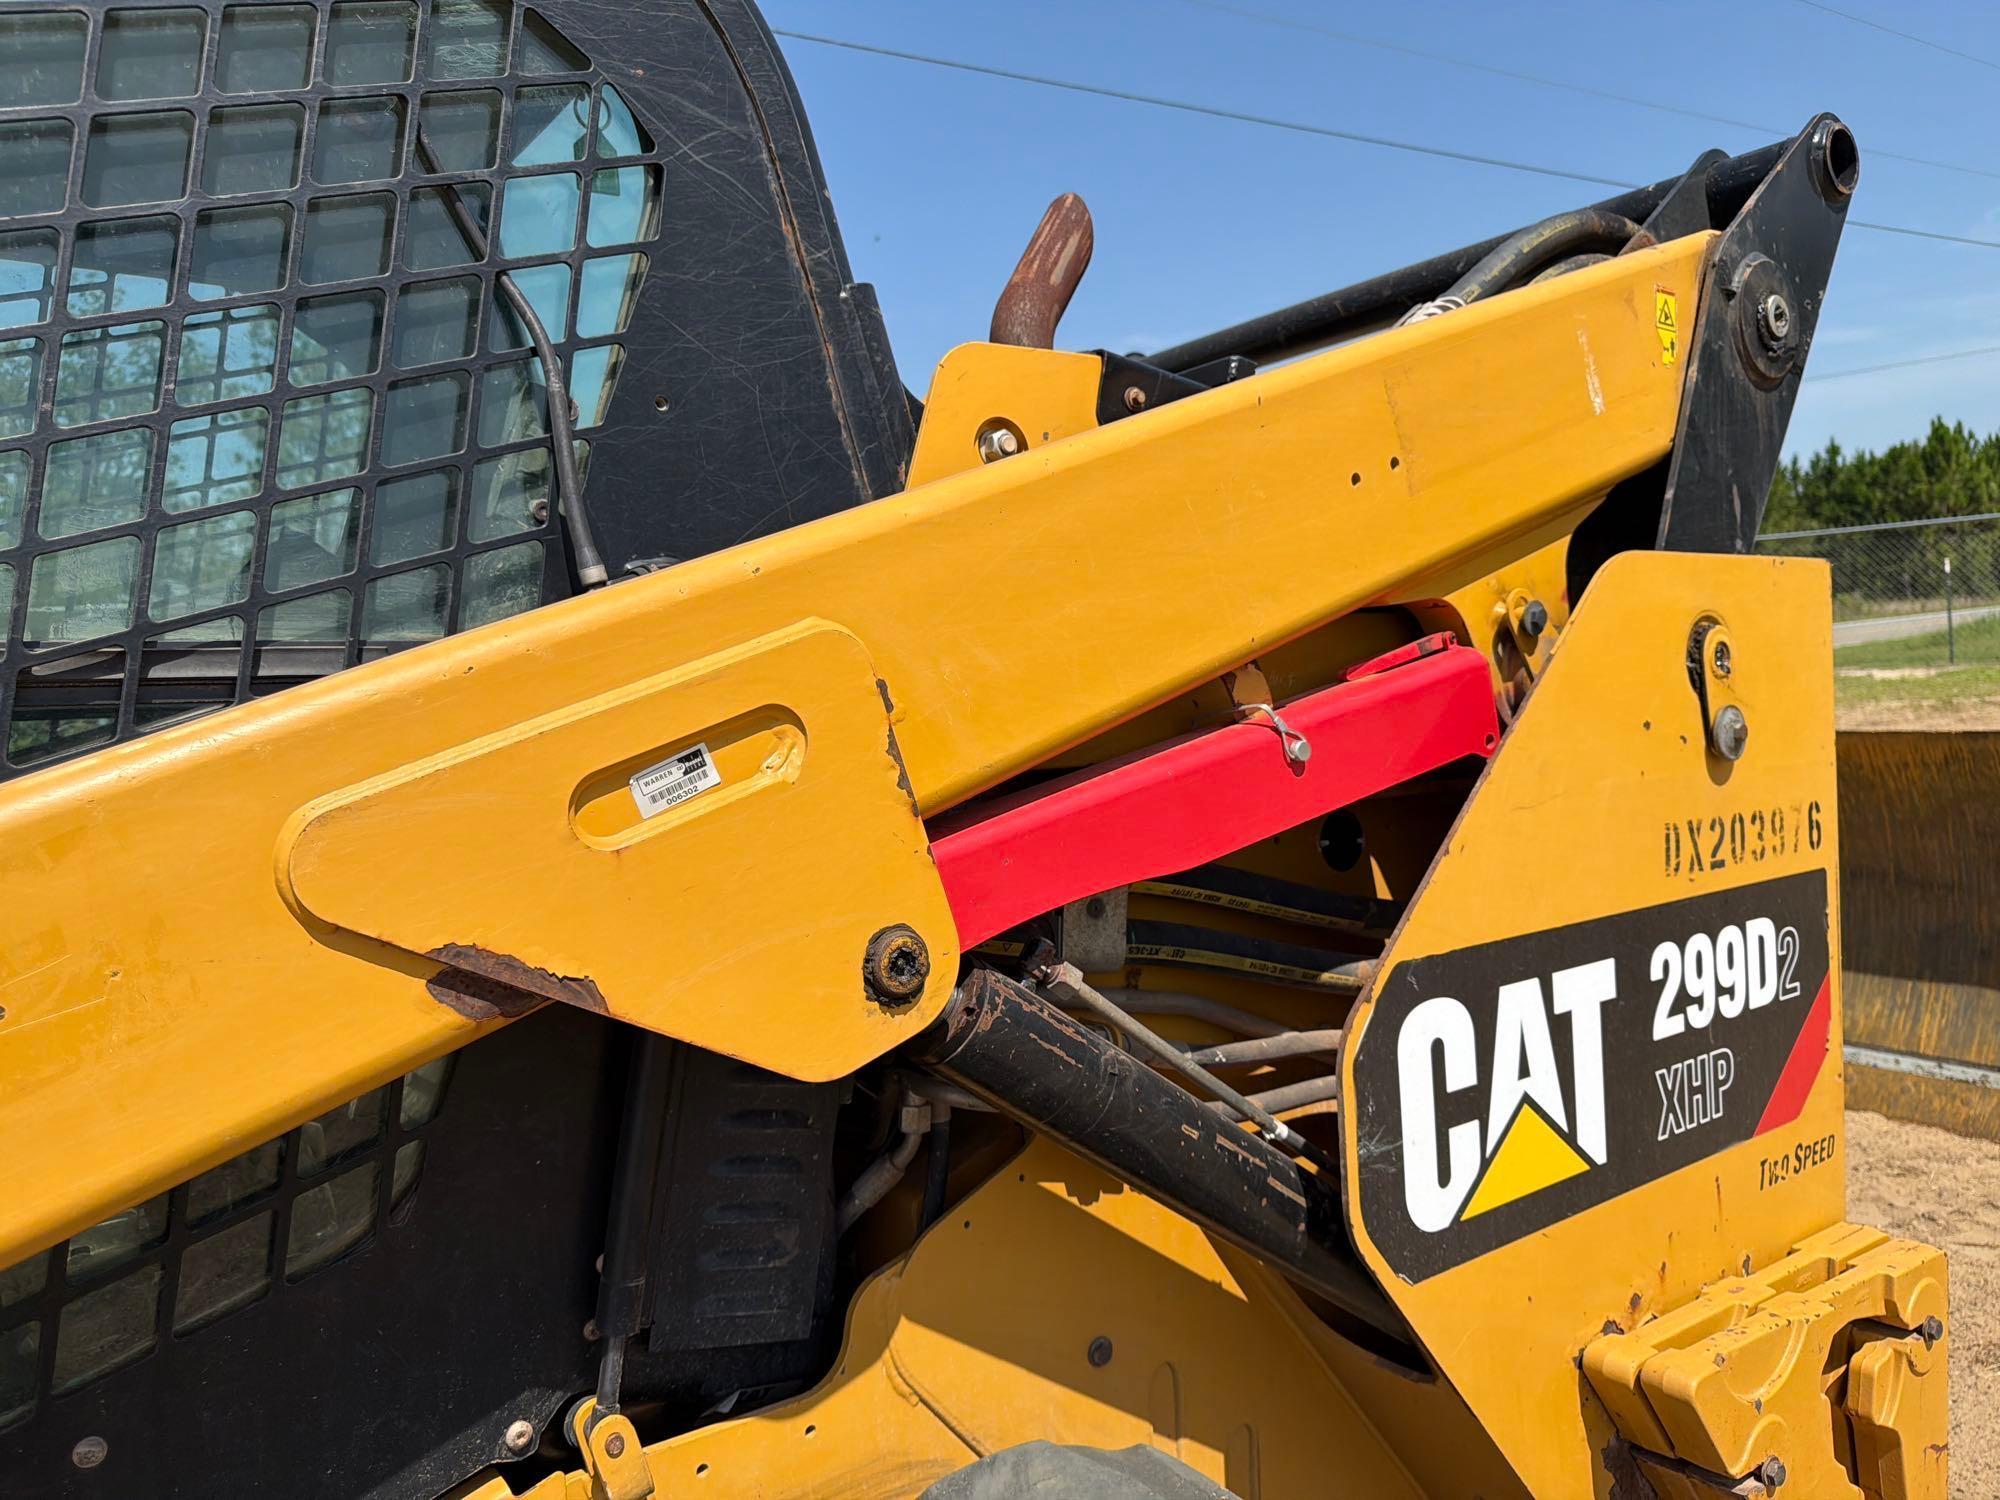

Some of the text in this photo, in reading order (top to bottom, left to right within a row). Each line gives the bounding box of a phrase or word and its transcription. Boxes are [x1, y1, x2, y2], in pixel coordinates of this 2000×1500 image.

[643, 770, 673, 788] WARREN
[666, 786, 699, 805] 006302
[1665, 801, 1822, 879] DX203976
[1650, 916, 1801, 1042] 299D2
[1397, 957, 1617, 1233] CAT
[1655, 1047, 1735, 1142] XHP
